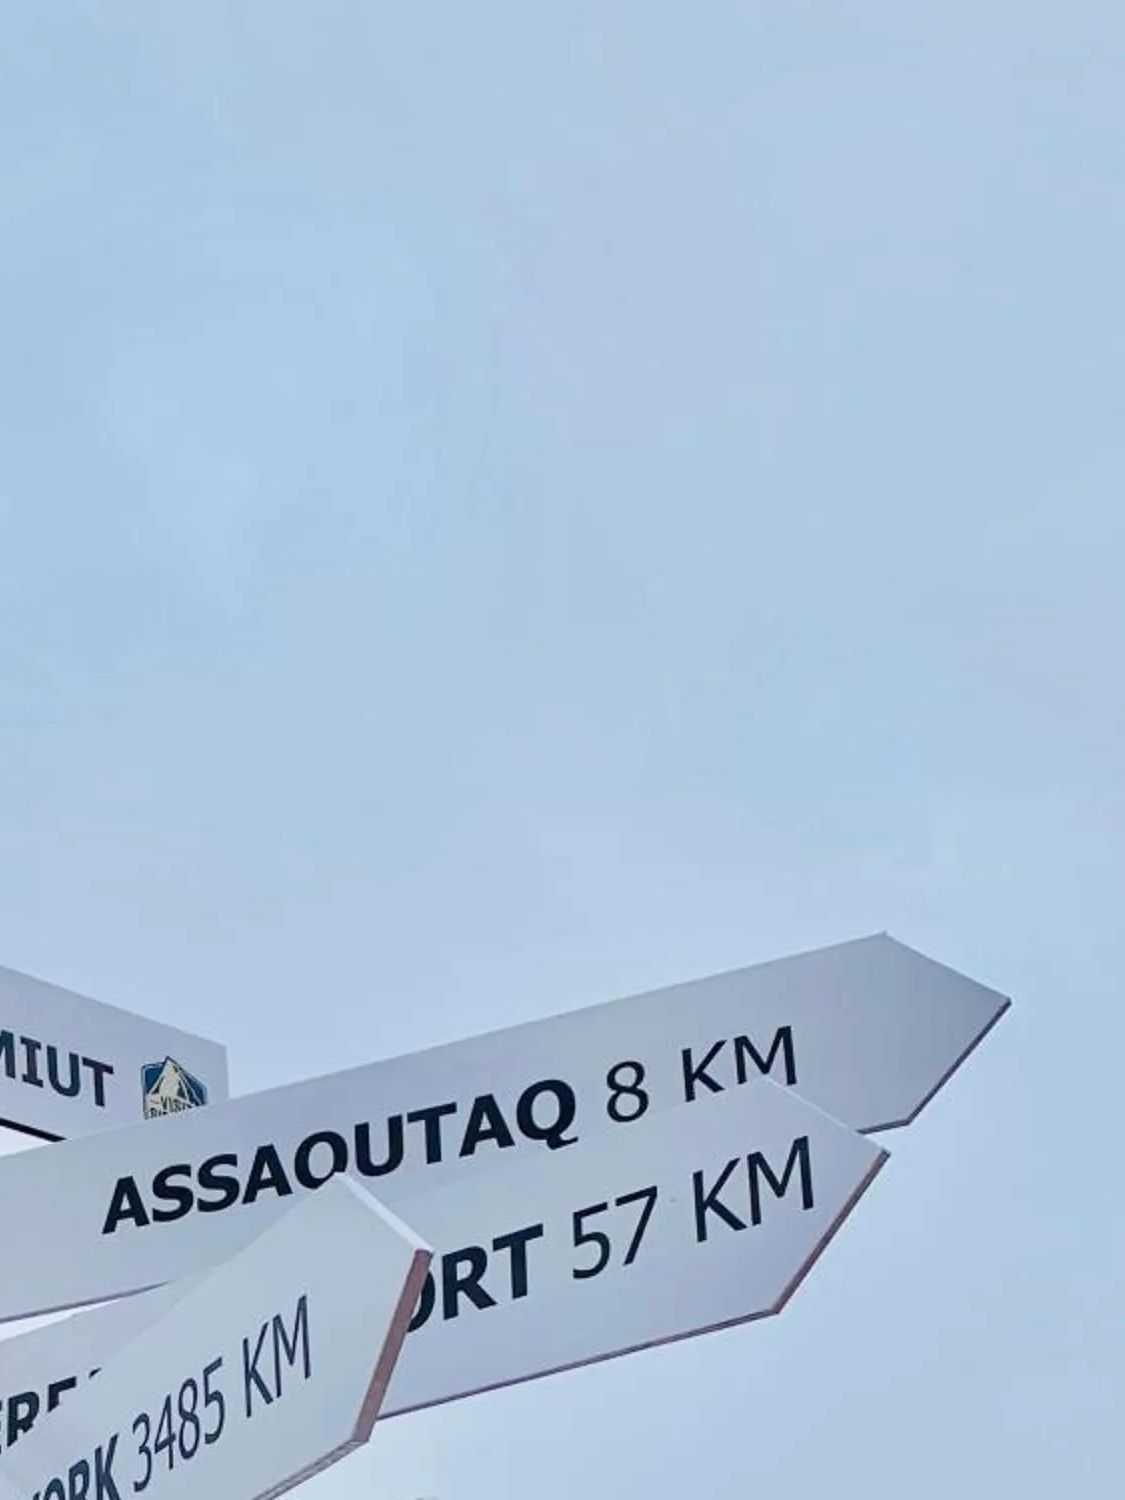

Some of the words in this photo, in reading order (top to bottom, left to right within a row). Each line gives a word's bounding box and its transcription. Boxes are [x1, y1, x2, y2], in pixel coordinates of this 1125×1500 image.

[605, 1060, 649, 1123] 8
[681, 1025, 798, 1101] KM
[572, 1186, 659, 1280] 57
[692, 1135, 815, 1243] KM
[133, 1356, 225, 1492] 3485
[243, 1294, 312, 1418] KM
